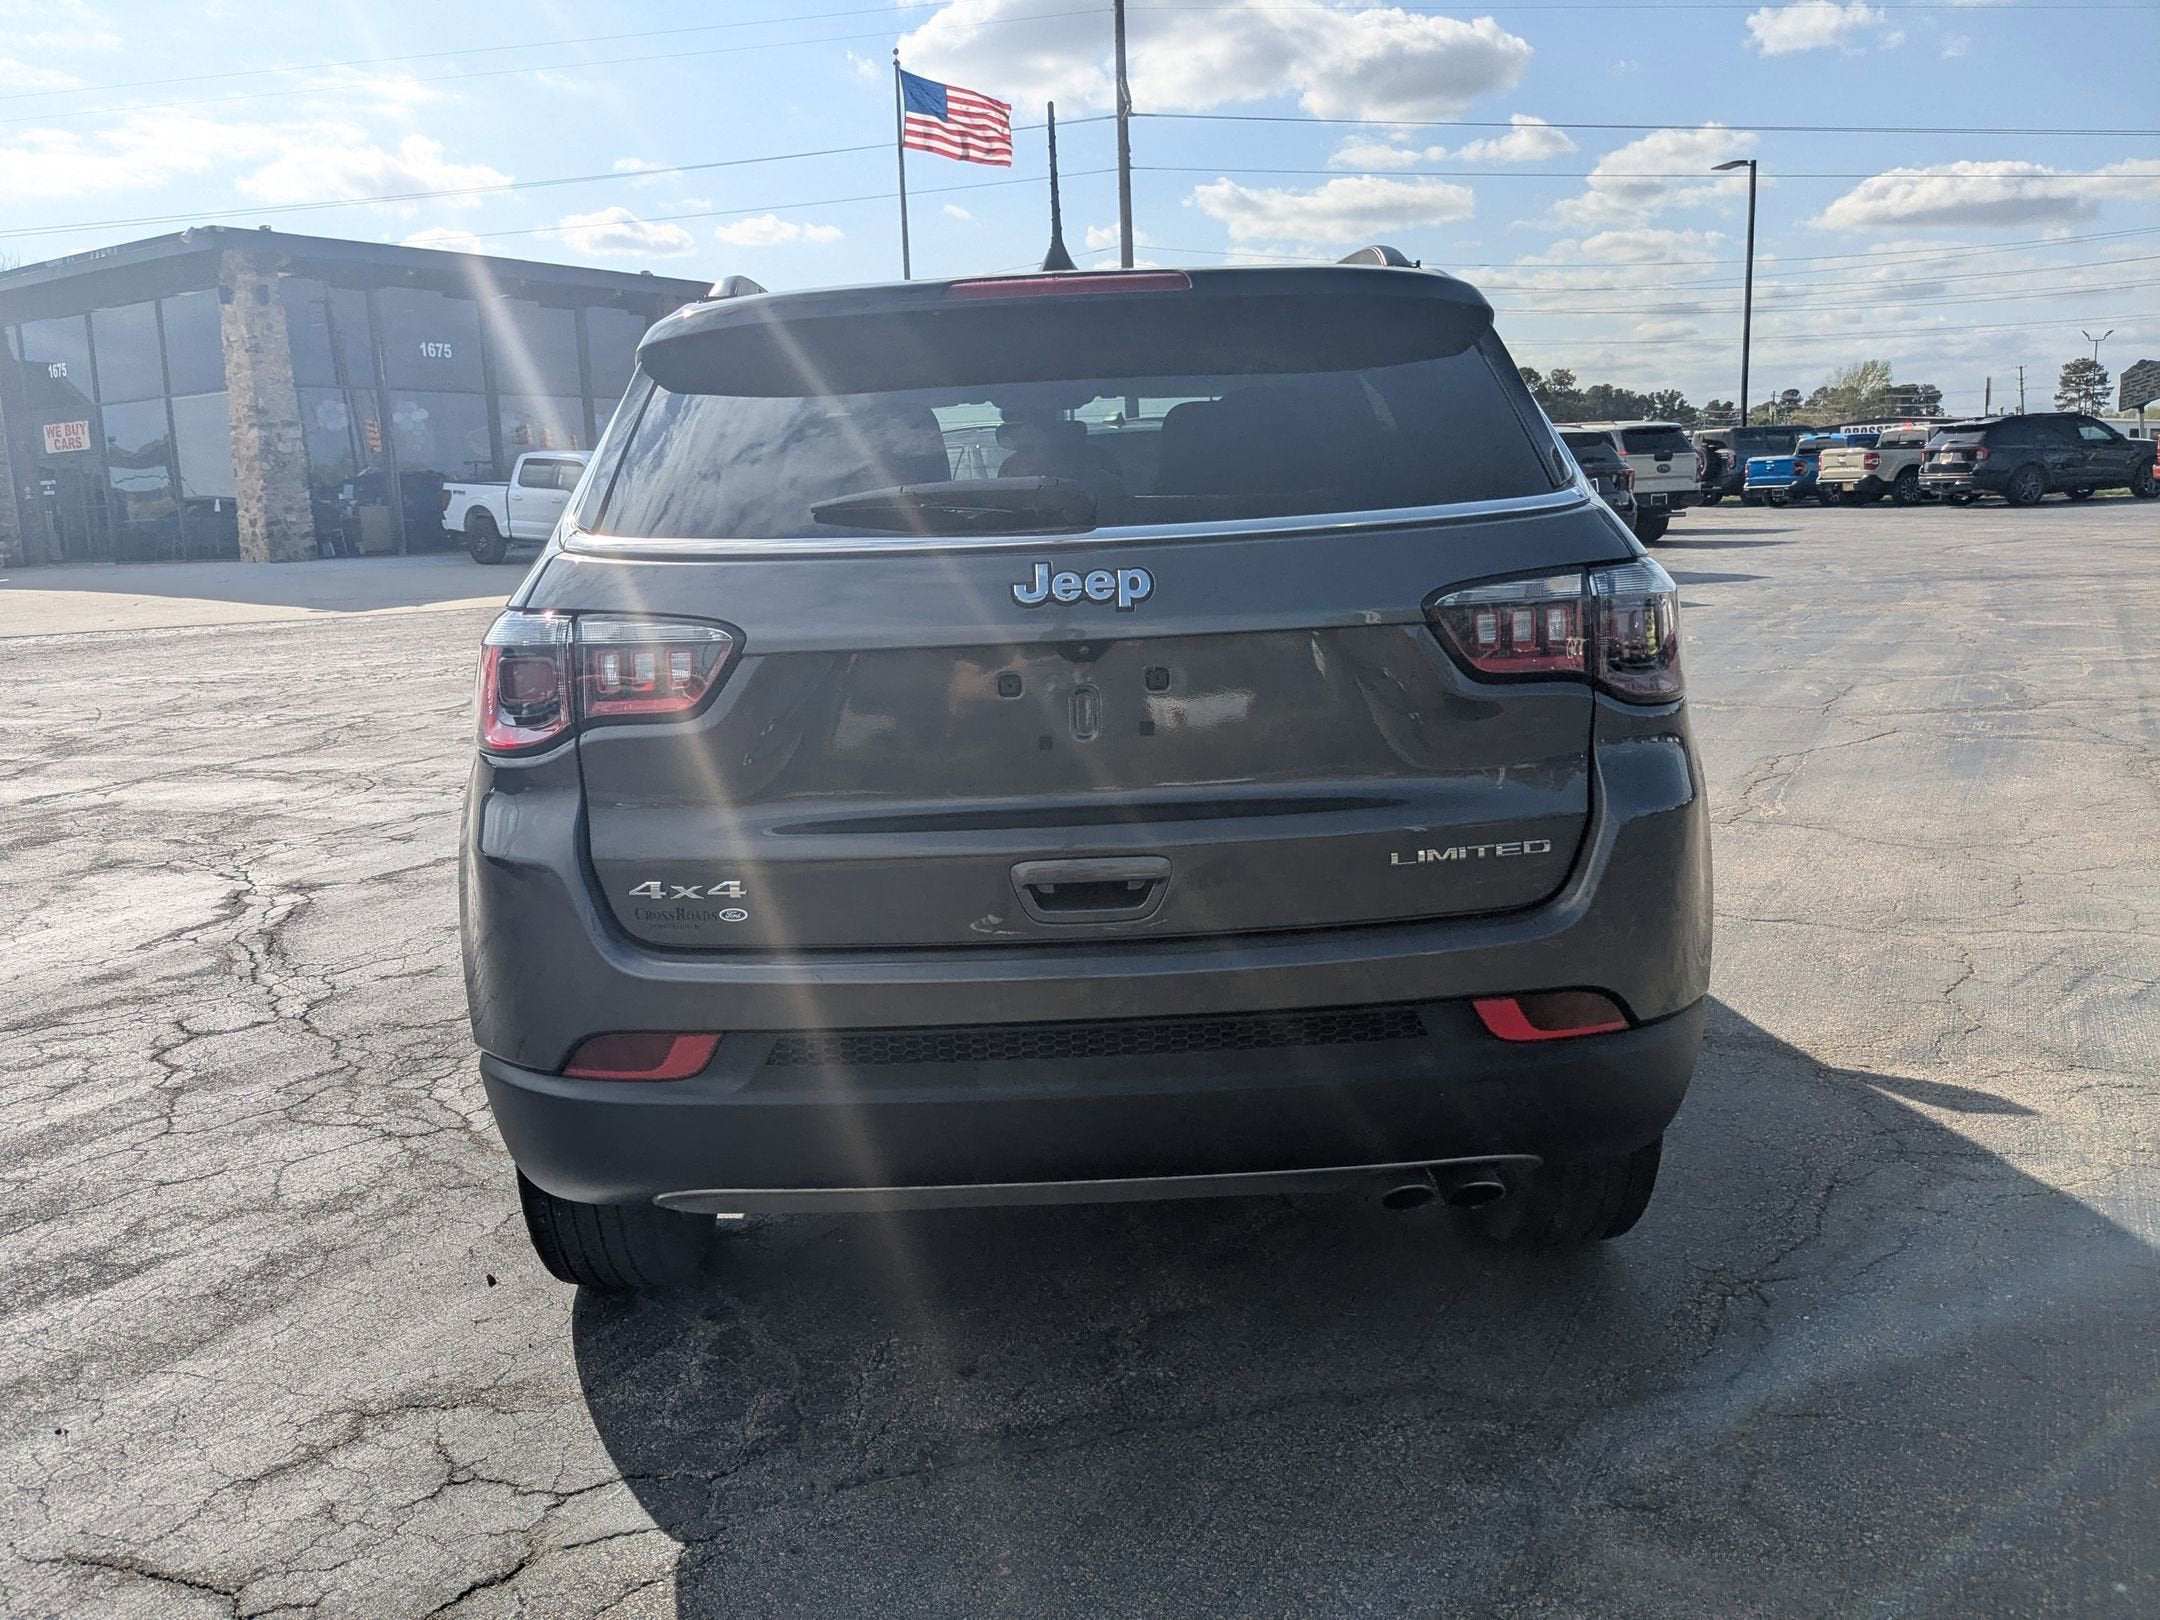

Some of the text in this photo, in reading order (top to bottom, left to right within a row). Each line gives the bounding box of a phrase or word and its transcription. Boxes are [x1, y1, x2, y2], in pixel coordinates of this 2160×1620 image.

[420, 342, 452, 358] 1675
[48, 363, 67, 379] 1675
[45, 423, 86, 439] WE BUY
[54, 437, 82, 450] CARS
[1012, 562, 1153, 610] Jeep
[1390, 839, 1551, 866] LIMITED
[628, 880, 748, 900] 4x4
